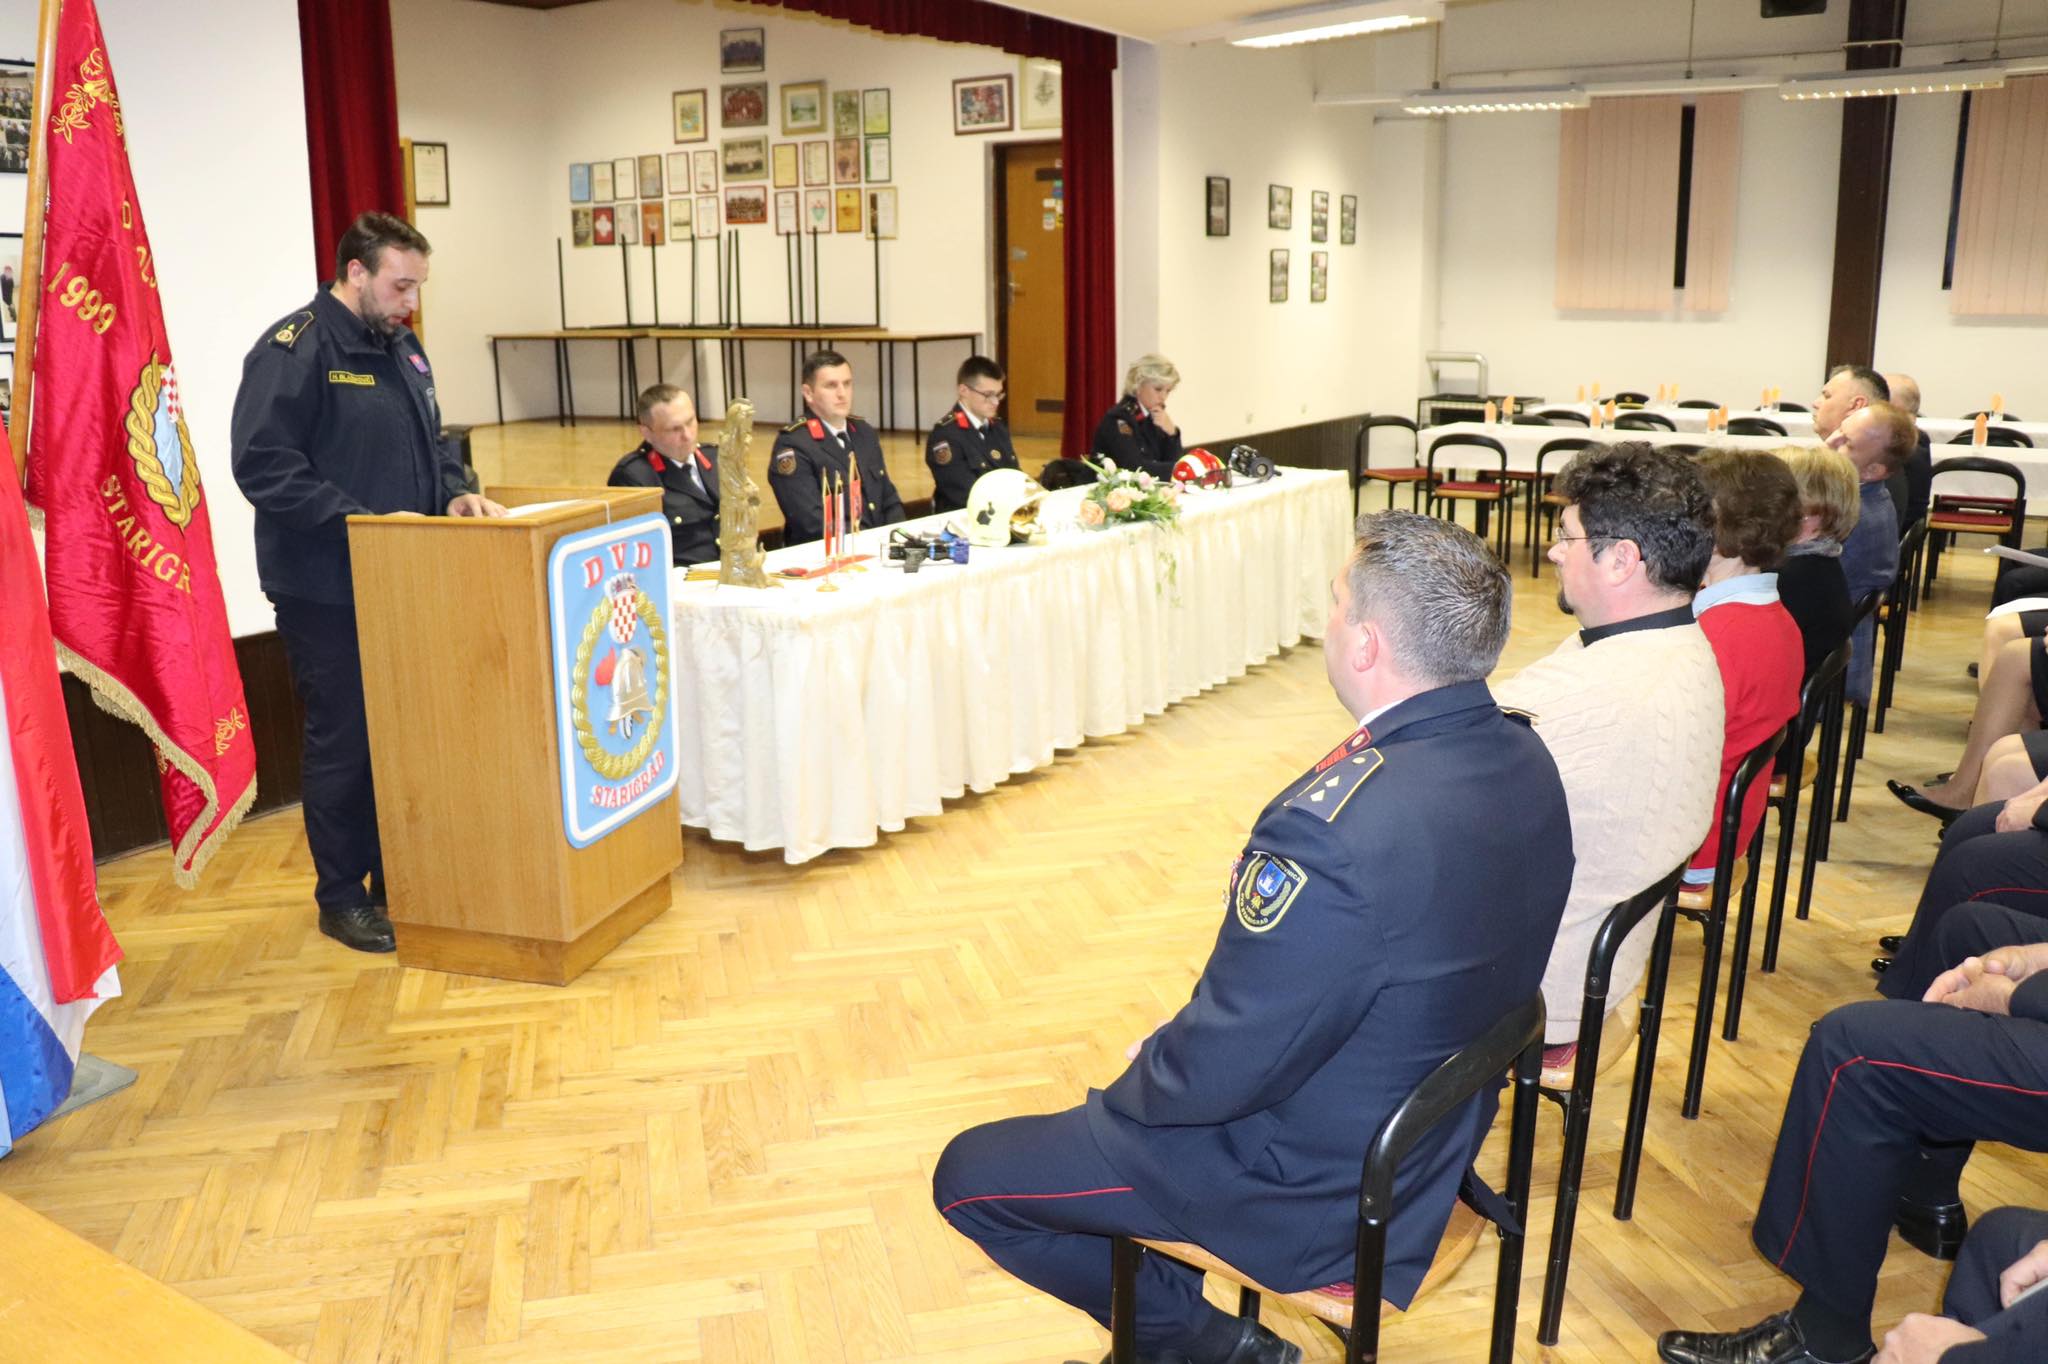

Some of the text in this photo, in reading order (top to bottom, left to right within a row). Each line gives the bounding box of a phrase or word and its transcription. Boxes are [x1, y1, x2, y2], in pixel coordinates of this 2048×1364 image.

[47, 262, 117, 335] 1999
[582, 542, 653, 588] DVD
[591, 750, 664, 808] STARIGRAD
